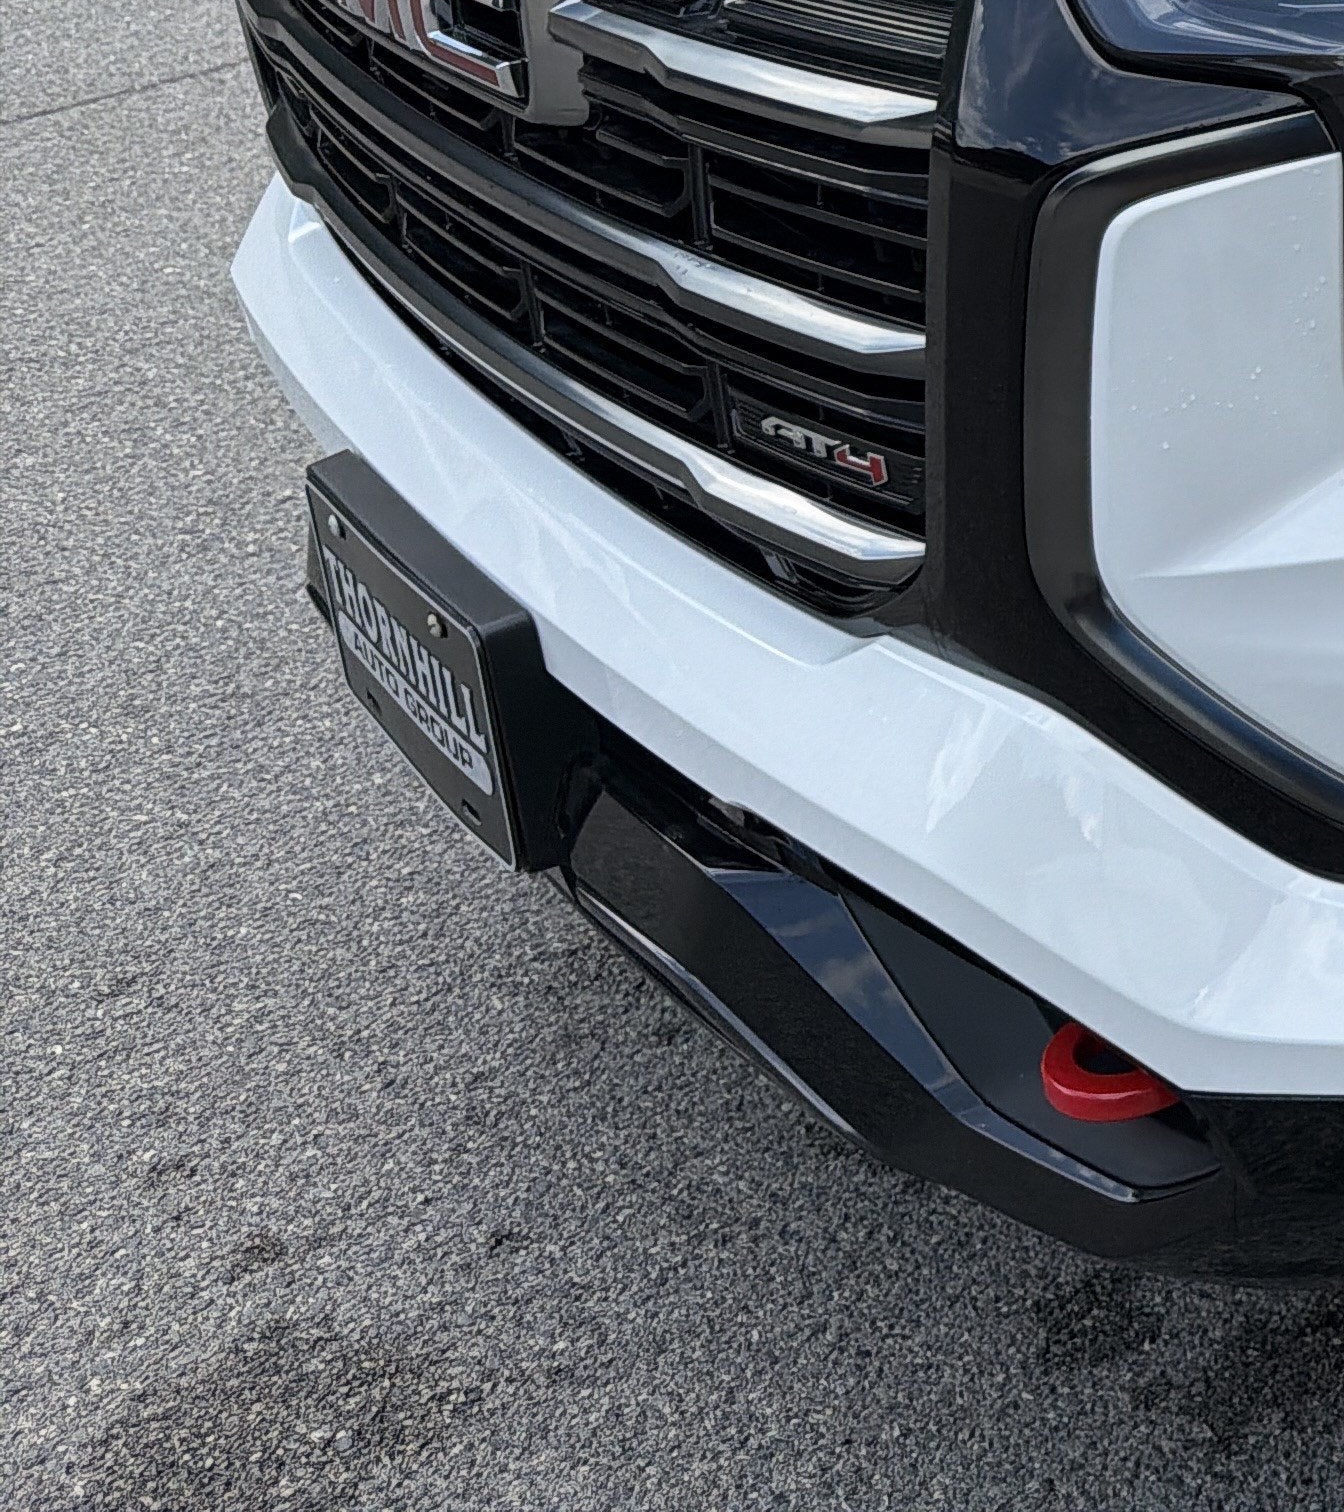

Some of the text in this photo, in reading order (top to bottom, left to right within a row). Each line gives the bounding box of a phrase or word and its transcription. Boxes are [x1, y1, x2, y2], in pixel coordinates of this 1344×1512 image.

[761, 415, 888, 486] AT4
[322, 543, 490, 754] THORNHILL
[353, 630, 474, 772] AUTO GROUP
